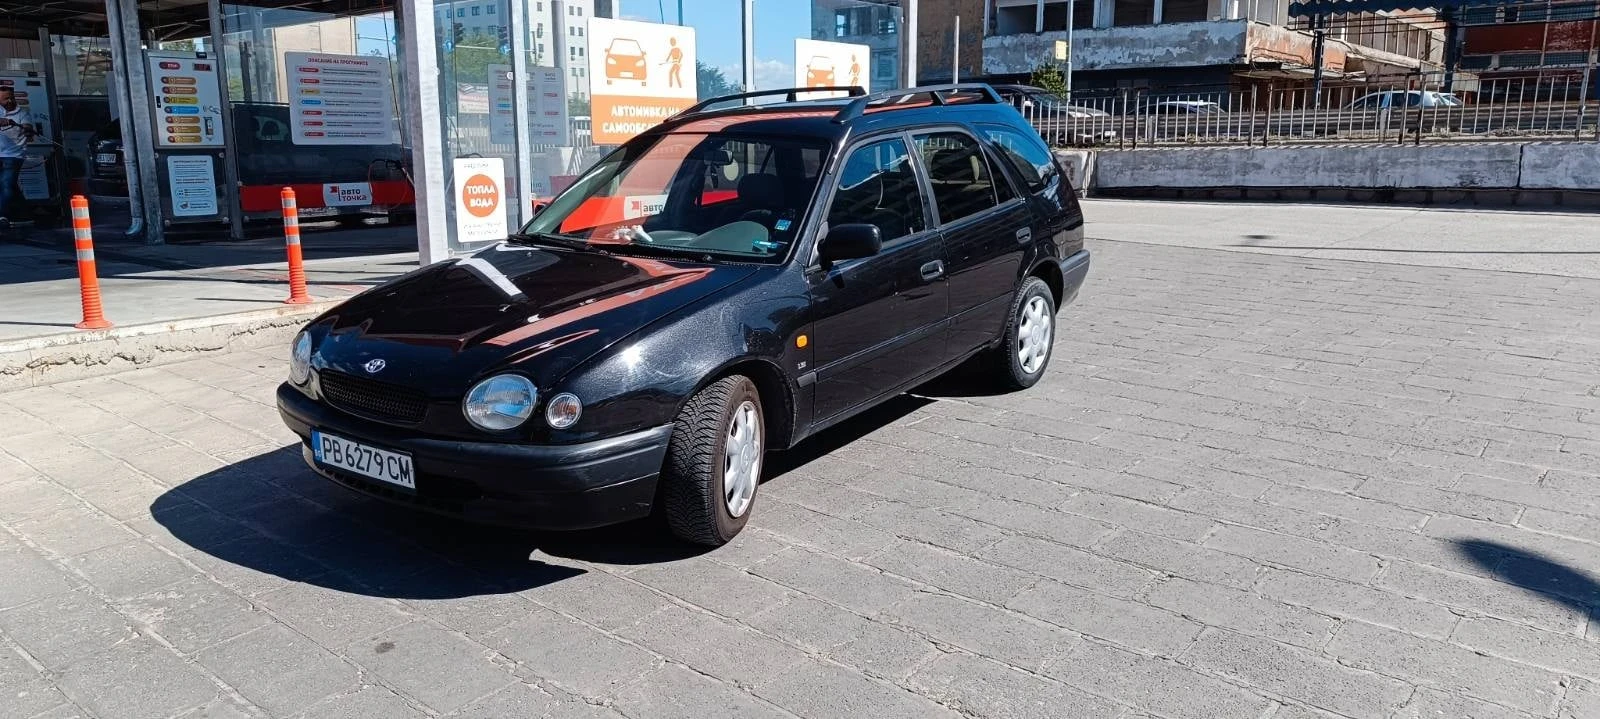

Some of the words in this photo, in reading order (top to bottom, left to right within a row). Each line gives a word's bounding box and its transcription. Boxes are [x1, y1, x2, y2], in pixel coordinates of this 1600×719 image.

[611, 105, 667, 117] АВТОМИВКА
[467, 185, 496, 195] ТОПЛА
[470, 198, 494, 208] ВОДА
[345, 443, 384, 476] 6279
[387, 455, 412, 484] CM
